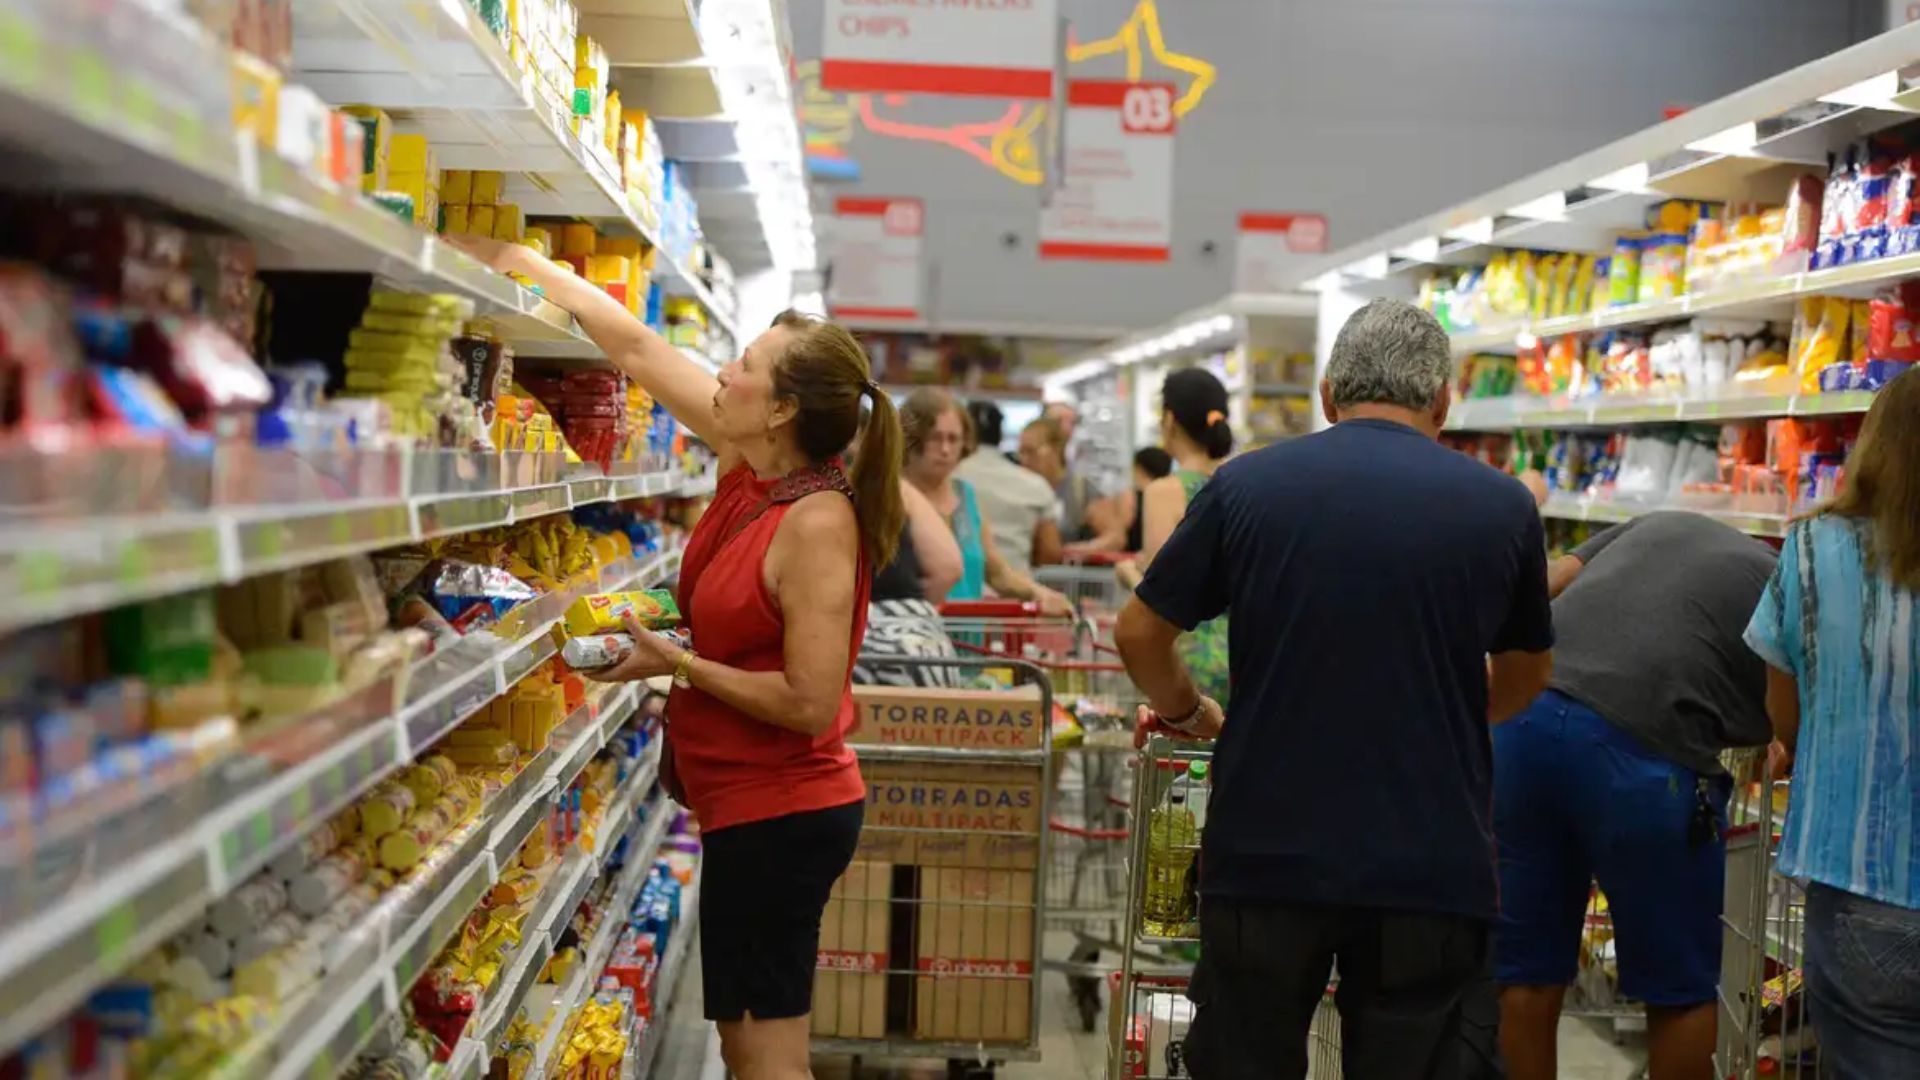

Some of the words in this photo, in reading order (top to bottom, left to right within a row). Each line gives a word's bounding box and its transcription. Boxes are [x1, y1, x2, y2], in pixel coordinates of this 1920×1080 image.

[838, 16, 910, 37] CHIPS
[1123, 87, 1172, 131] 03
[869, 704, 1034, 728] TORRADAS
[879, 726, 1026, 746] MULTIPACK
[871, 784, 1032, 808] TORRADAS
[878, 810, 1023, 832] MULTIPACK
